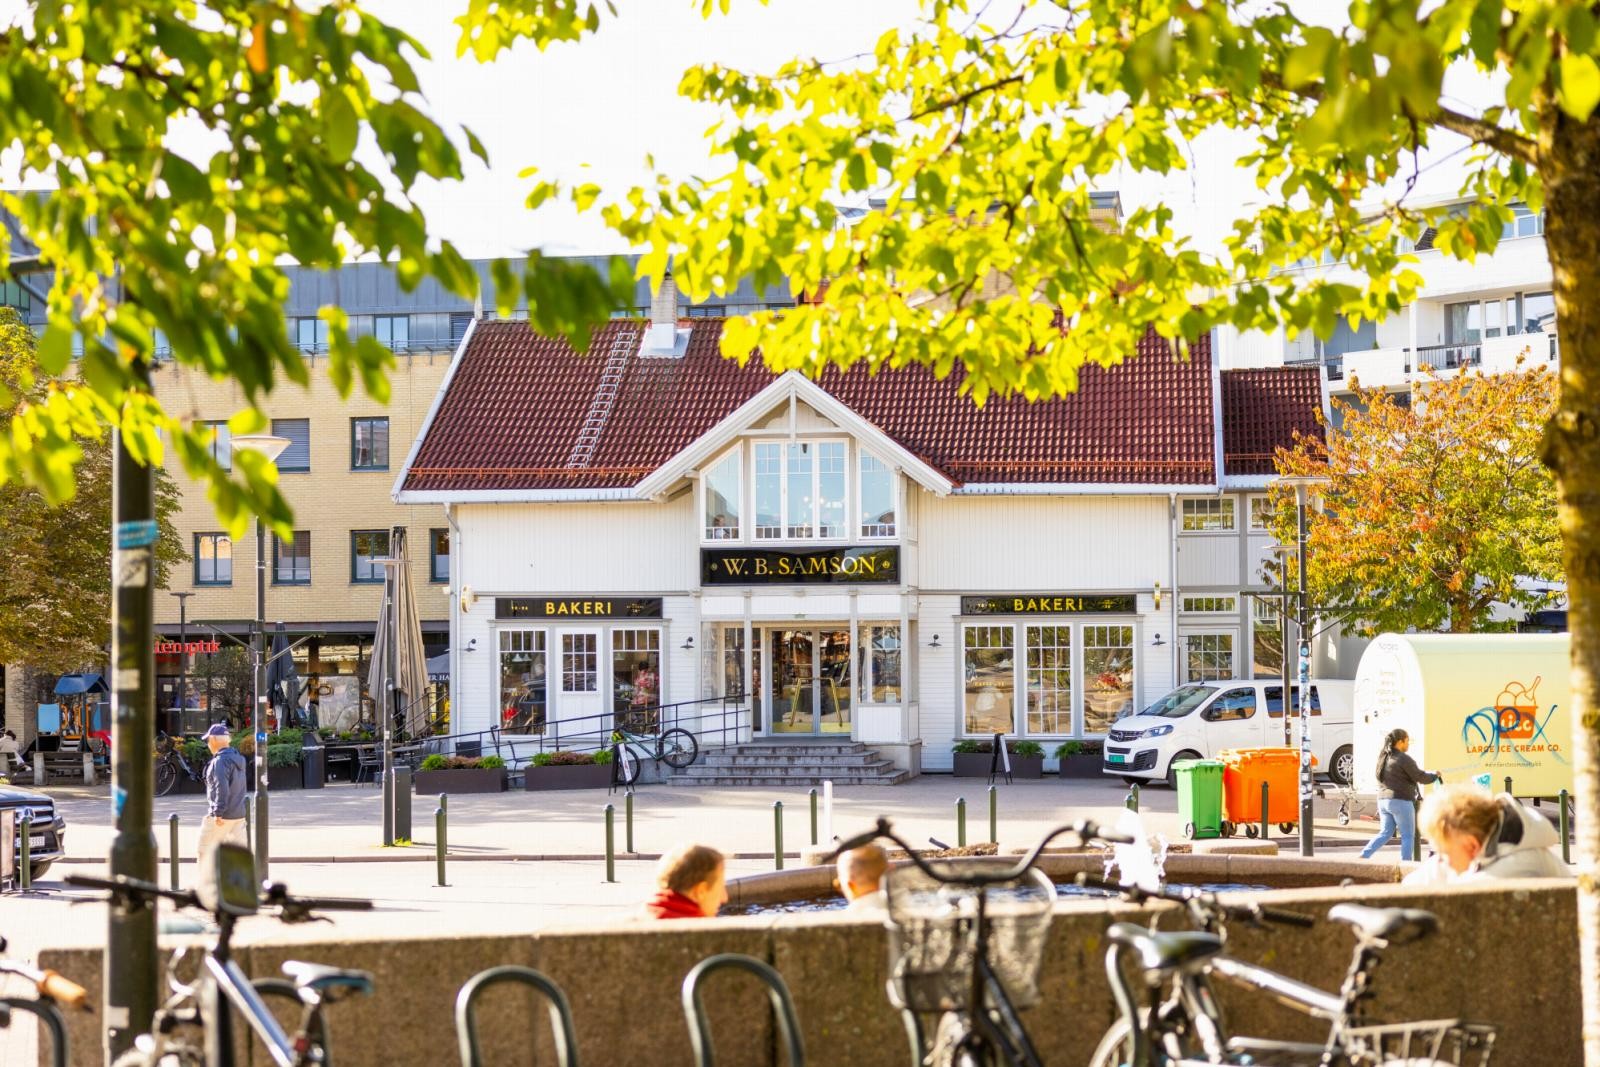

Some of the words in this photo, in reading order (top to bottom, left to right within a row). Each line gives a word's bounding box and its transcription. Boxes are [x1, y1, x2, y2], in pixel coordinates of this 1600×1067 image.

[722, 557, 748, 575] W.
[755, 557, 773, 575] B.
[778, 556, 877, 575] SAMSON
[545, 601, 612, 615] BAKERI
[1014, 598, 1083, 612] BAKERI
[1466, 745, 1495, 753] LARGE
[1497, 745, 1511, 753] ICE
[1514, 744, 1544, 752] CREAM
[1547, 744, 1562, 752] CO.
